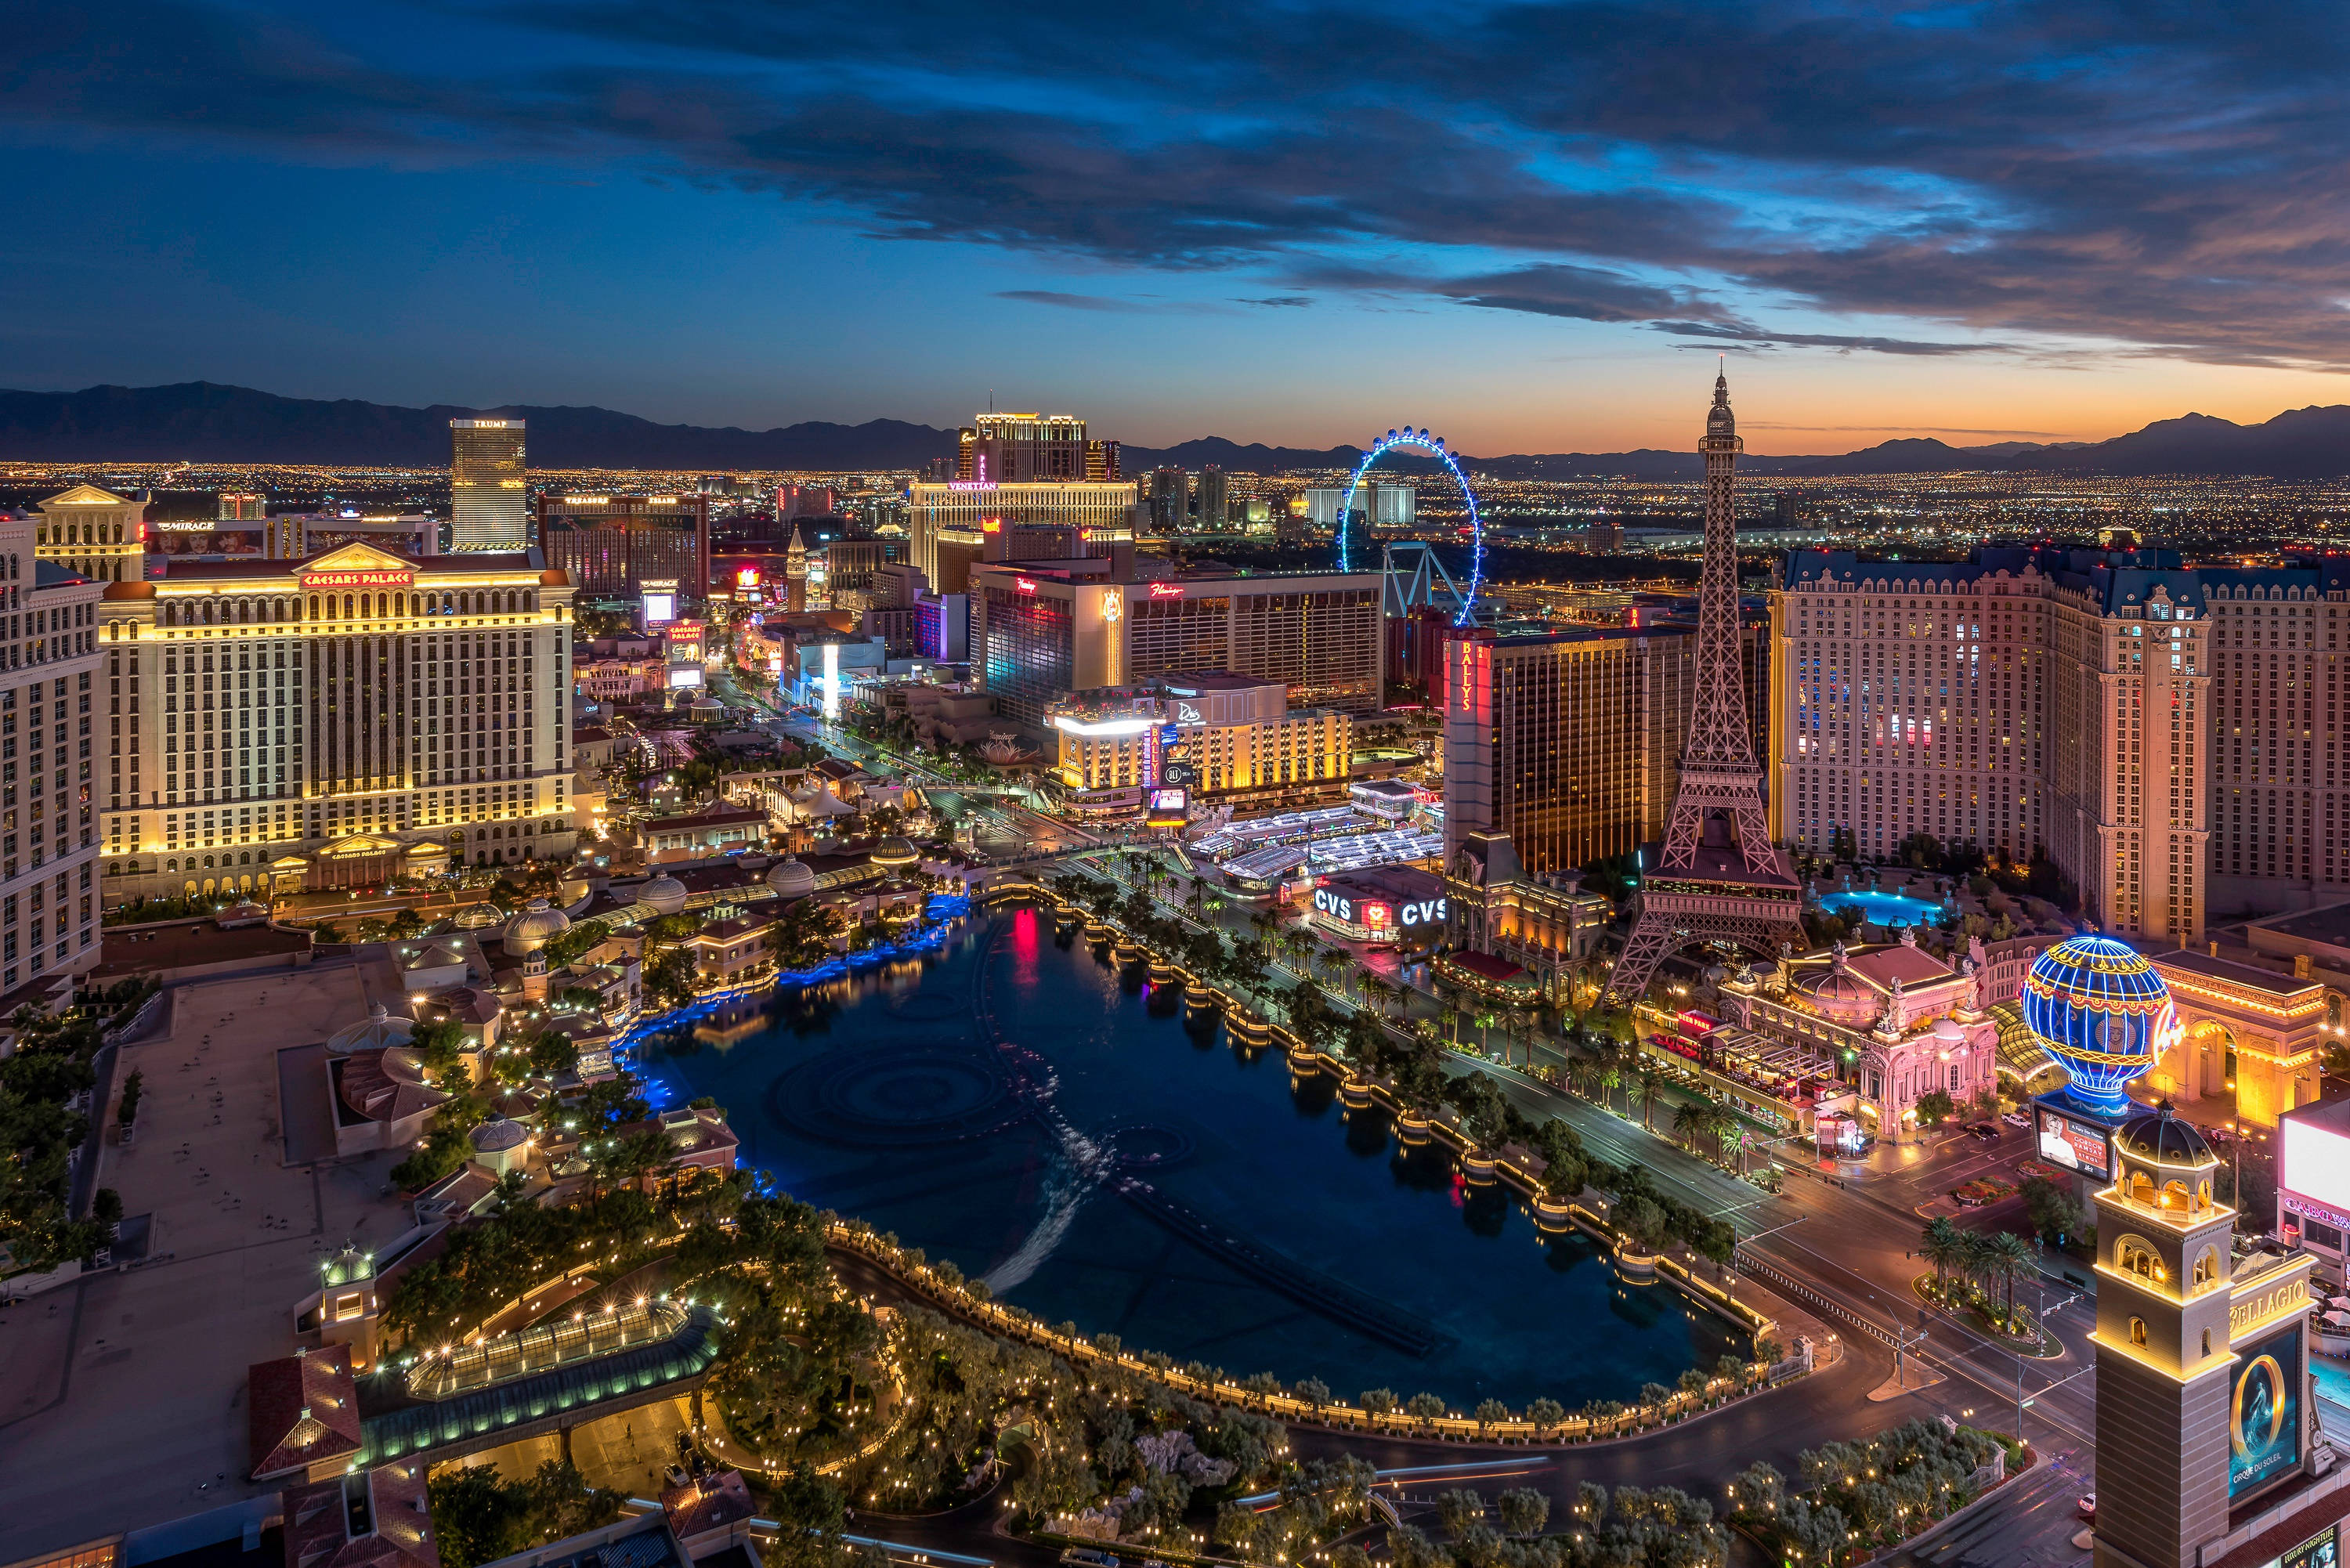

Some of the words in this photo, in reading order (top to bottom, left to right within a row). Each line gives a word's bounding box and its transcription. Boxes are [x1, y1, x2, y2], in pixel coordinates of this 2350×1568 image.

[172, 522, 215, 532] MIRAGE
[304, 574, 359, 586] CAESARS
[362, 573, 410, 584] PALACE
[1151, 583, 1184, 597] Flamingo
[1461, 641, 1473, 711] BALLYS
[1151, 728, 1159, 781] BALLYS
[1169, 770, 1178, 779] BLT
[1314, 889, 1351, 920] CVS
[1401, 898, 1446, 926] CVS
[2158, 968, 2224, 991] MONUMENTAL
[2230, 987, 2272, 1004] FLAVORS
[1694, 1018, 1710, 1031] PARK
[2073, 1136, 2102, 1151] GORDON
[2073, 1142, 2102, 1157] RAMSAY
[2284, 1198, 2333, 1222] CABO
[2229, 1278, 2305, 1333] BELLAGIO
[2232, 1466, 2254, 1483] CIRQUE
[2254, 1461, 2263, 1472] DU
[2262, 1452, 2282, 1468] SOLEIL
[2284, 1544, 2305, 1564] LUXURY
[2305, 1526, 2334, 1551] NIGHTLIFE
